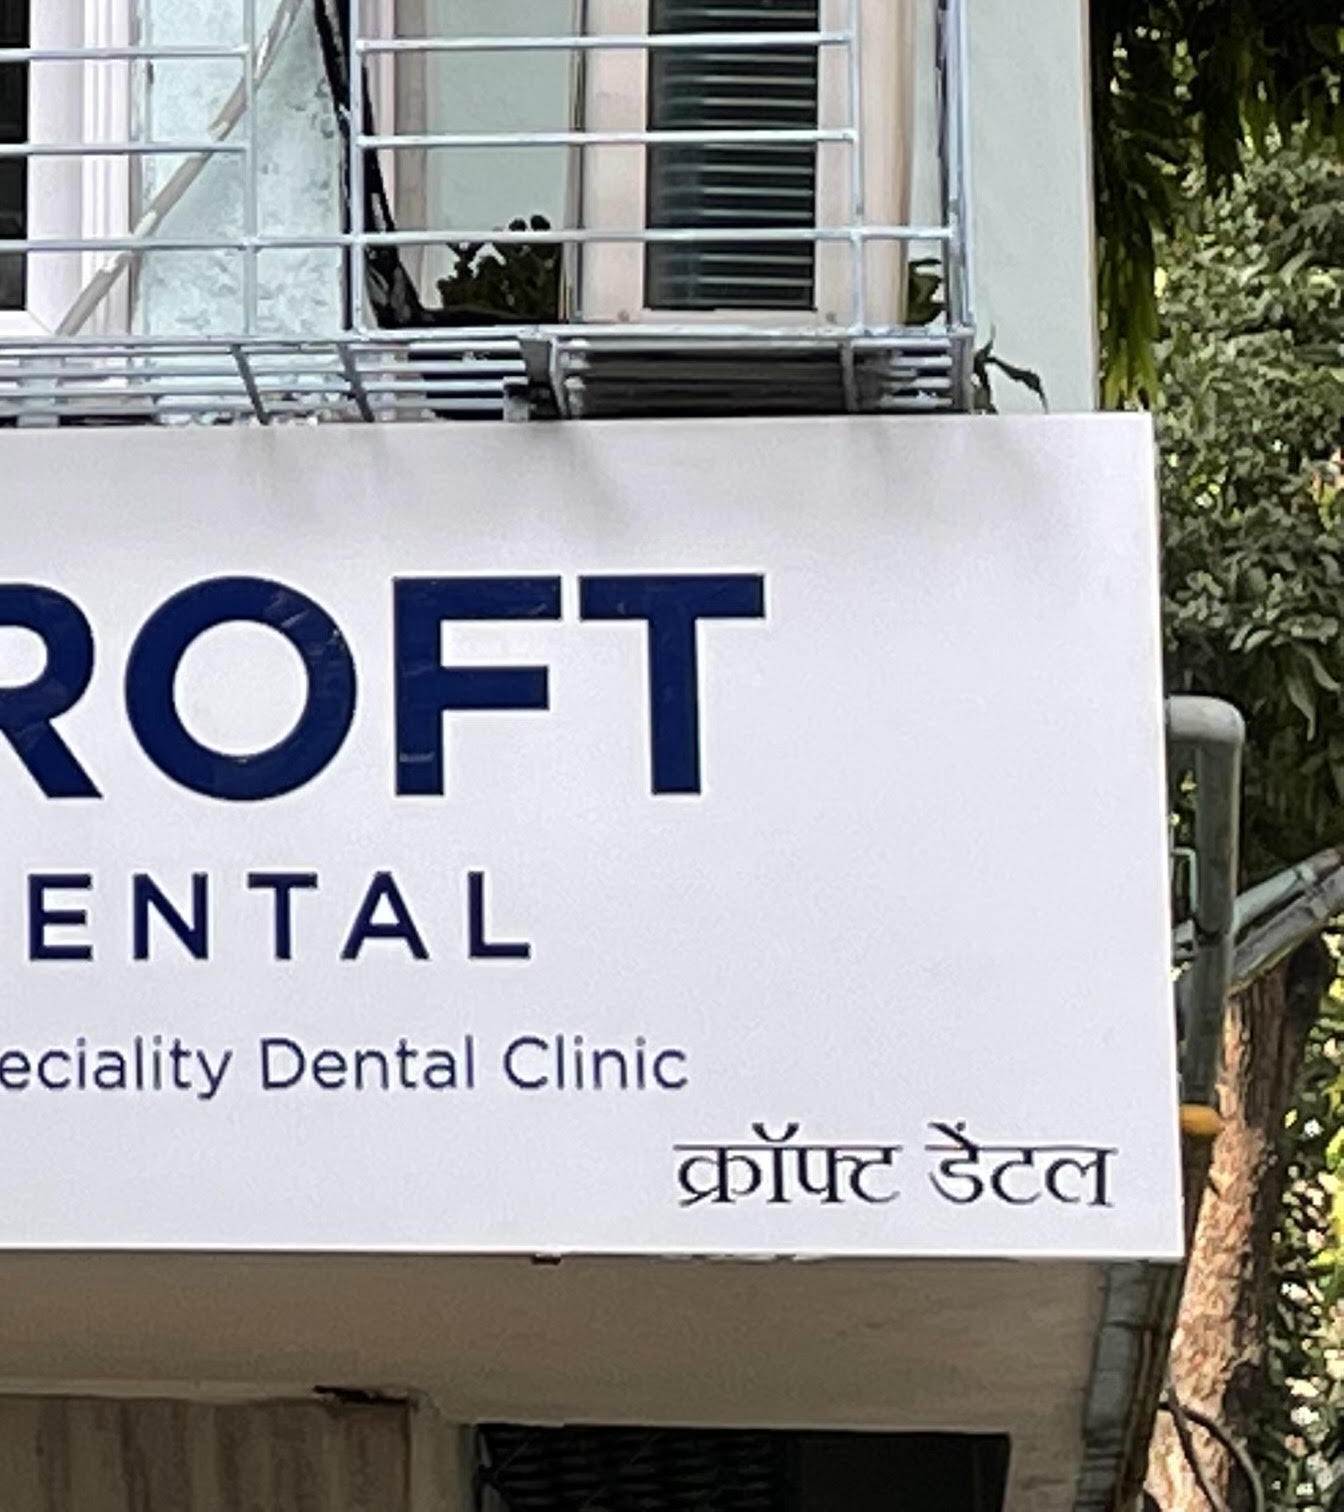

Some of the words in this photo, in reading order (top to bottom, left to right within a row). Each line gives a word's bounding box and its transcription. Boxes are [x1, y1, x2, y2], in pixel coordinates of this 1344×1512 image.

[260, 1034, 475, 1091] Dental
[503, 1034, 688, 1091] Clinic
[924, 1121, 1118, 1208] डेंटल
